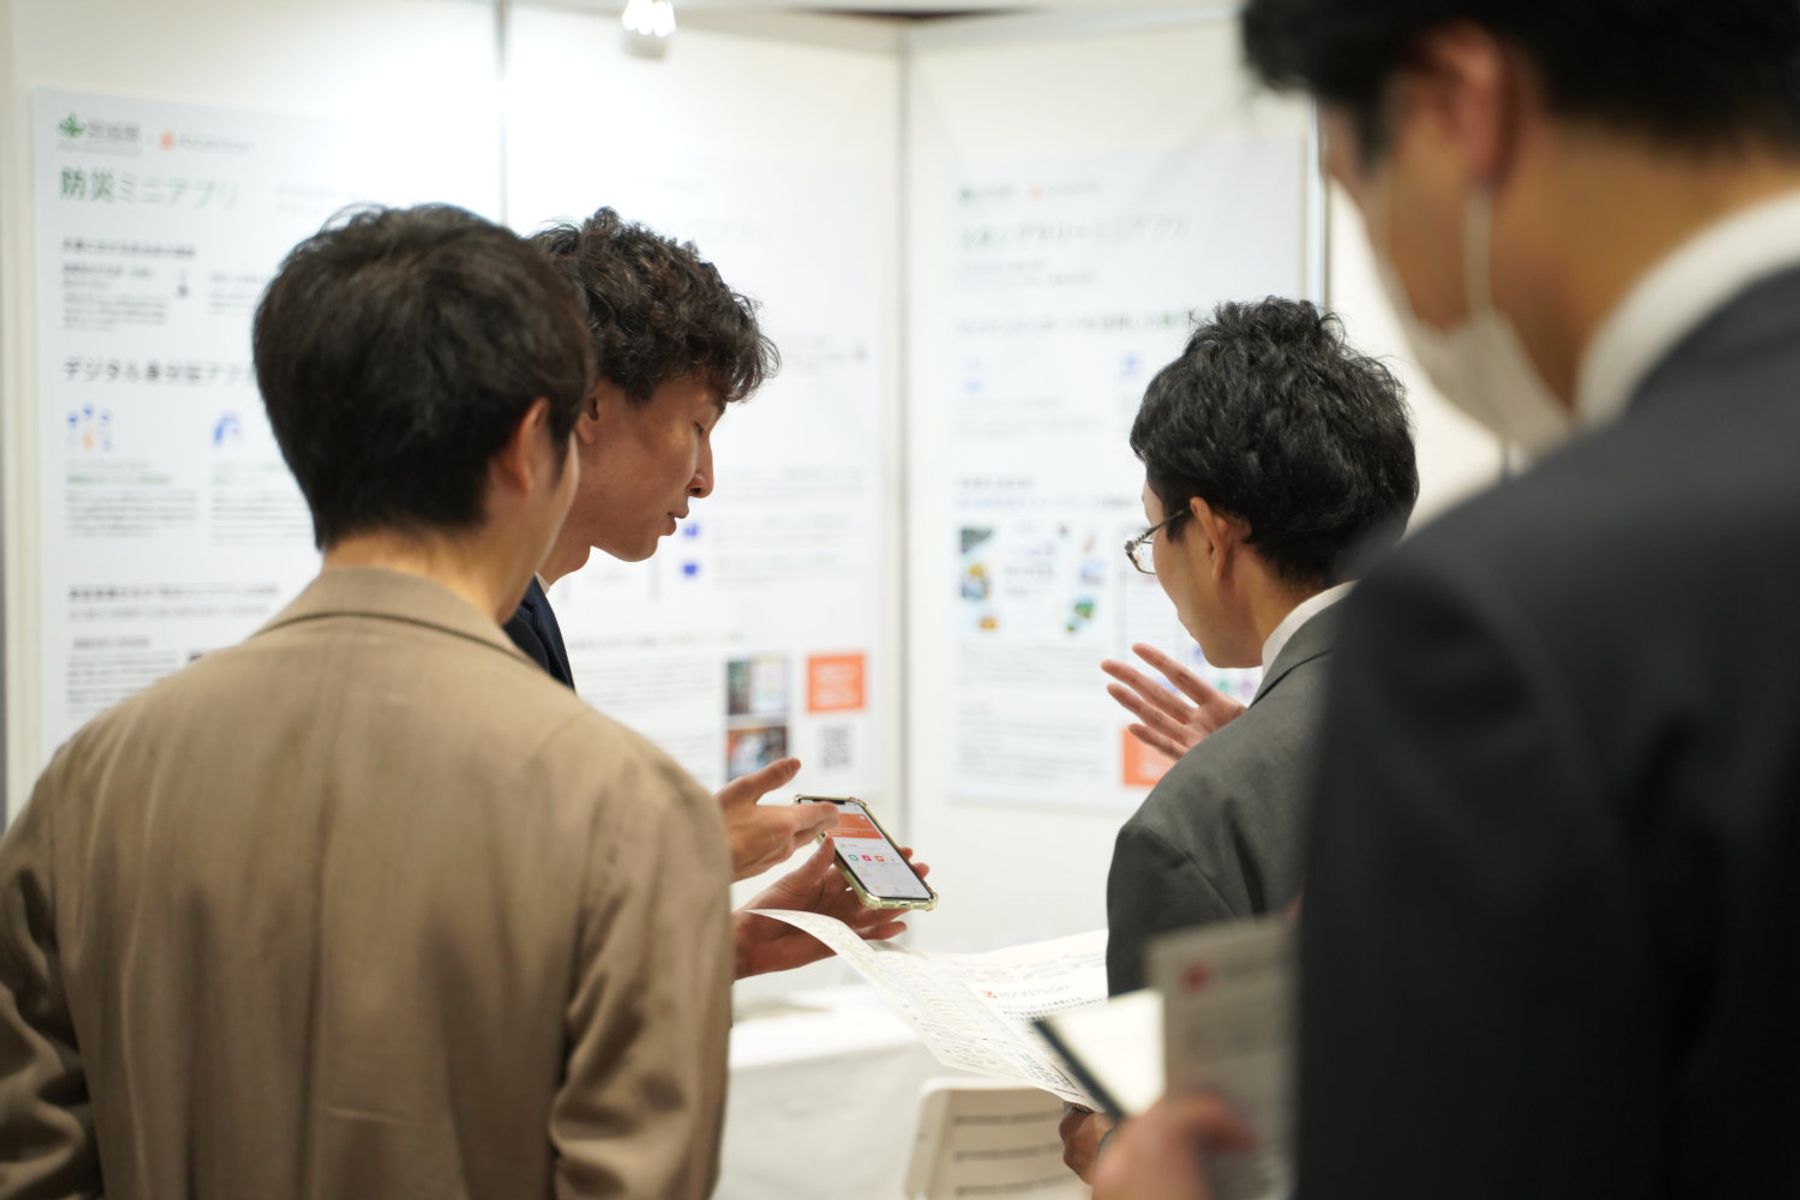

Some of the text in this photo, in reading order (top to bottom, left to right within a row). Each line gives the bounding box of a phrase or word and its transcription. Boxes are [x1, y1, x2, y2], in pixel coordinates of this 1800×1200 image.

[60, 166, 239, 209] 防災ミニアプリ
